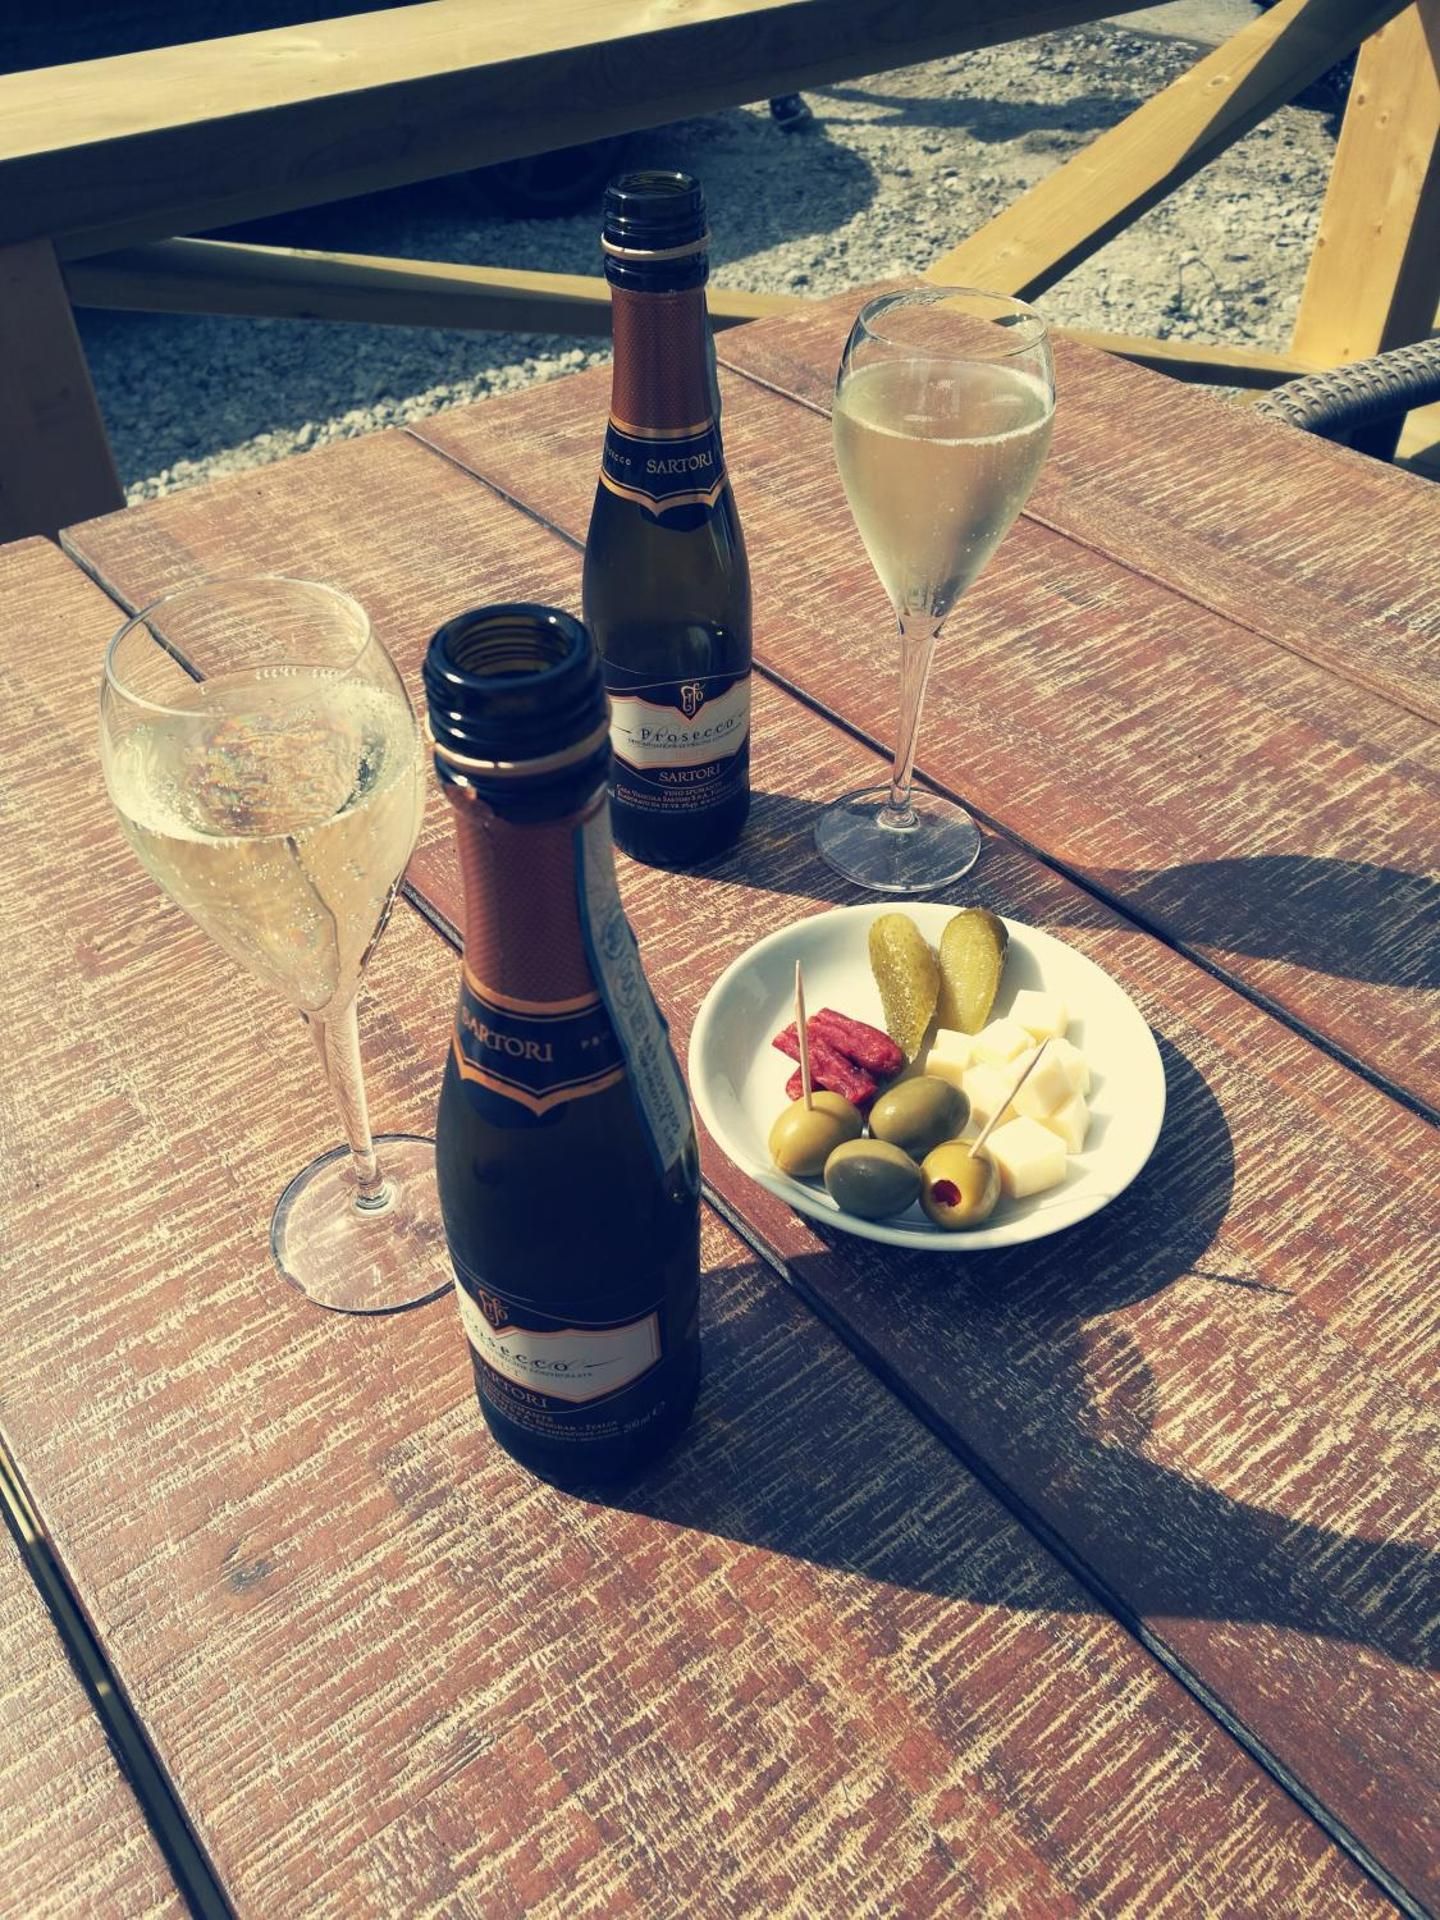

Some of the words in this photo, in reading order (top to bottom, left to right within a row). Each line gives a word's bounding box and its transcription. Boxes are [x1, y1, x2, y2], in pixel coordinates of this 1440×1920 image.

[646, 450, 714, 474] SARTORI
[641, 719, 734, 741] Prosecco
[659, 764, 721, 782] SARTORI
[462, 1005, 553, 1062] SARTORI
